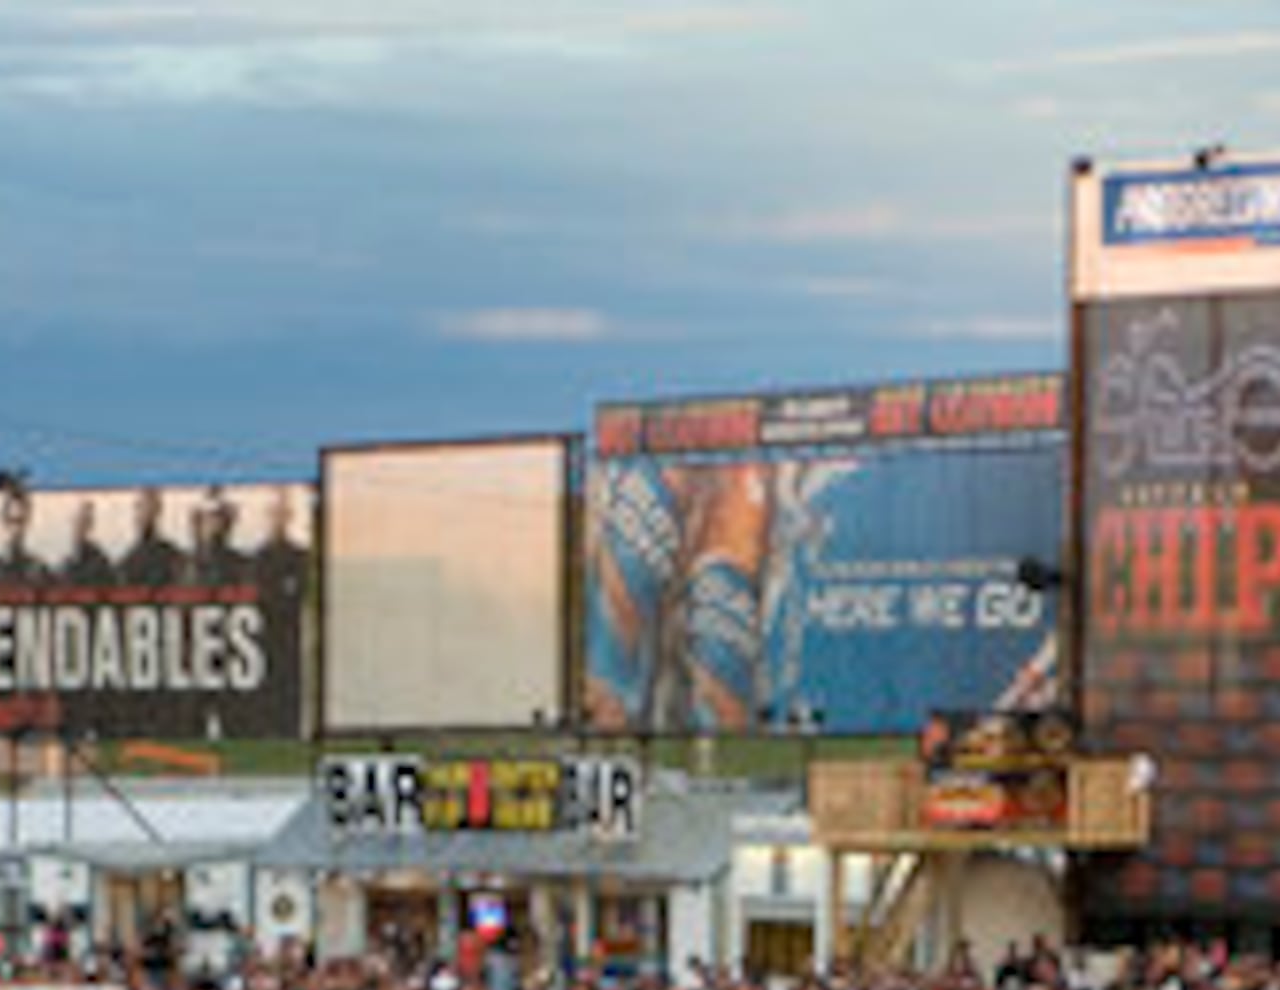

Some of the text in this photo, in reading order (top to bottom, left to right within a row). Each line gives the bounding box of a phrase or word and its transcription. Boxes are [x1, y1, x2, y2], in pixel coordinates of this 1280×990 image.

[976, 580, 1044, 629] GO
[326, 762, 424, 829] BAR
[563, 762, 637, 831] BAR
